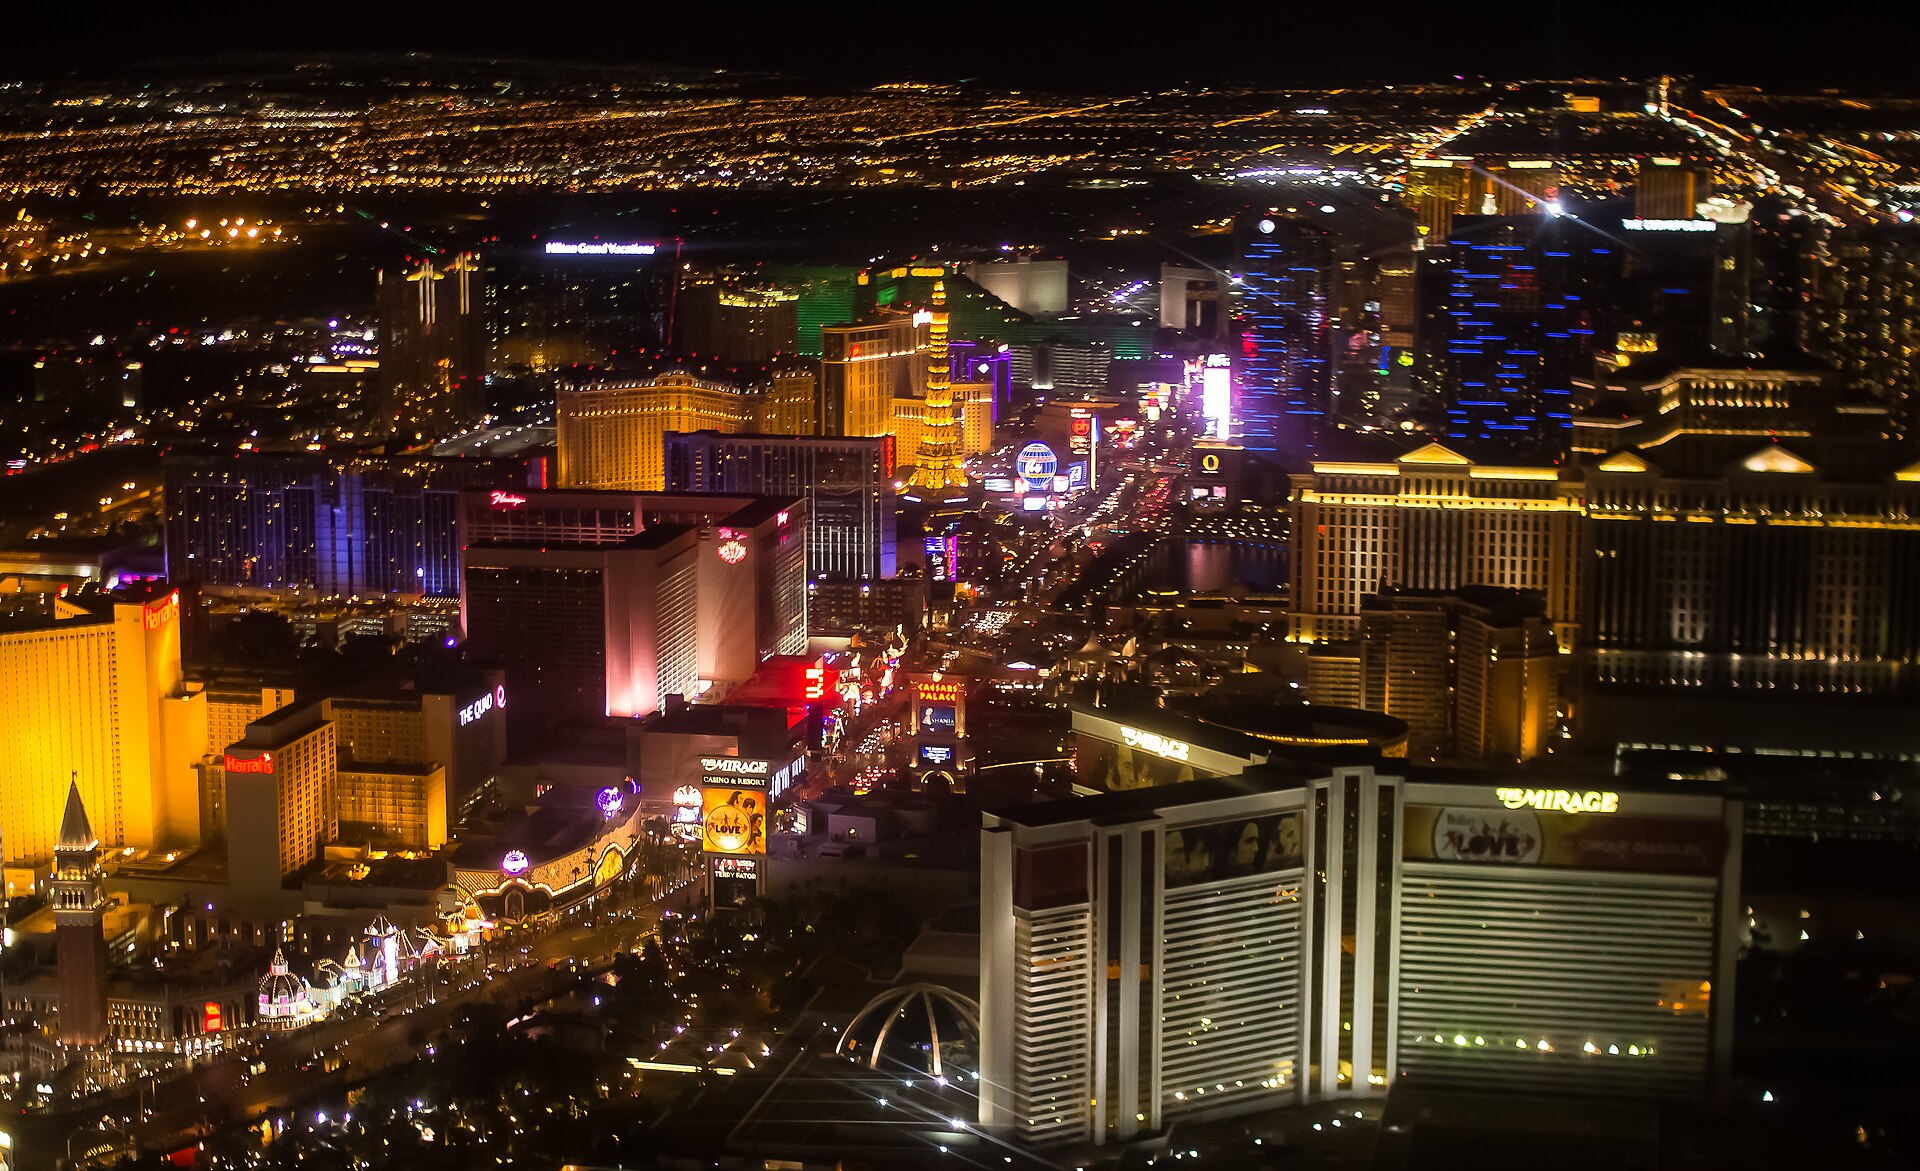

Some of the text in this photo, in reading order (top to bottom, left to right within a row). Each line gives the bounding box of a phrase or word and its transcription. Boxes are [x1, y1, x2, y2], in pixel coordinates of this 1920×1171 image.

[917, 683, 958, 693] CAESARS
[919, 692, 956, 701] PALACE
[459, 704, 474, 727] THE
[474, 692, 493, 719] QUAD
[1136, 730, 1190, 761] MIRAGE
[716, 759, 768, 774] MIRAGE
[703, 776, 729, 784] CASINO
[737, 778, 765, 786] RESORT
[1495, 787, 1620, 814] THE MIRAGE
[715, 824, 741, 834] LOVE
[1456, 834, 1520, 857] LOVE
[714, 870, 757, 880] TERRY FATOR
